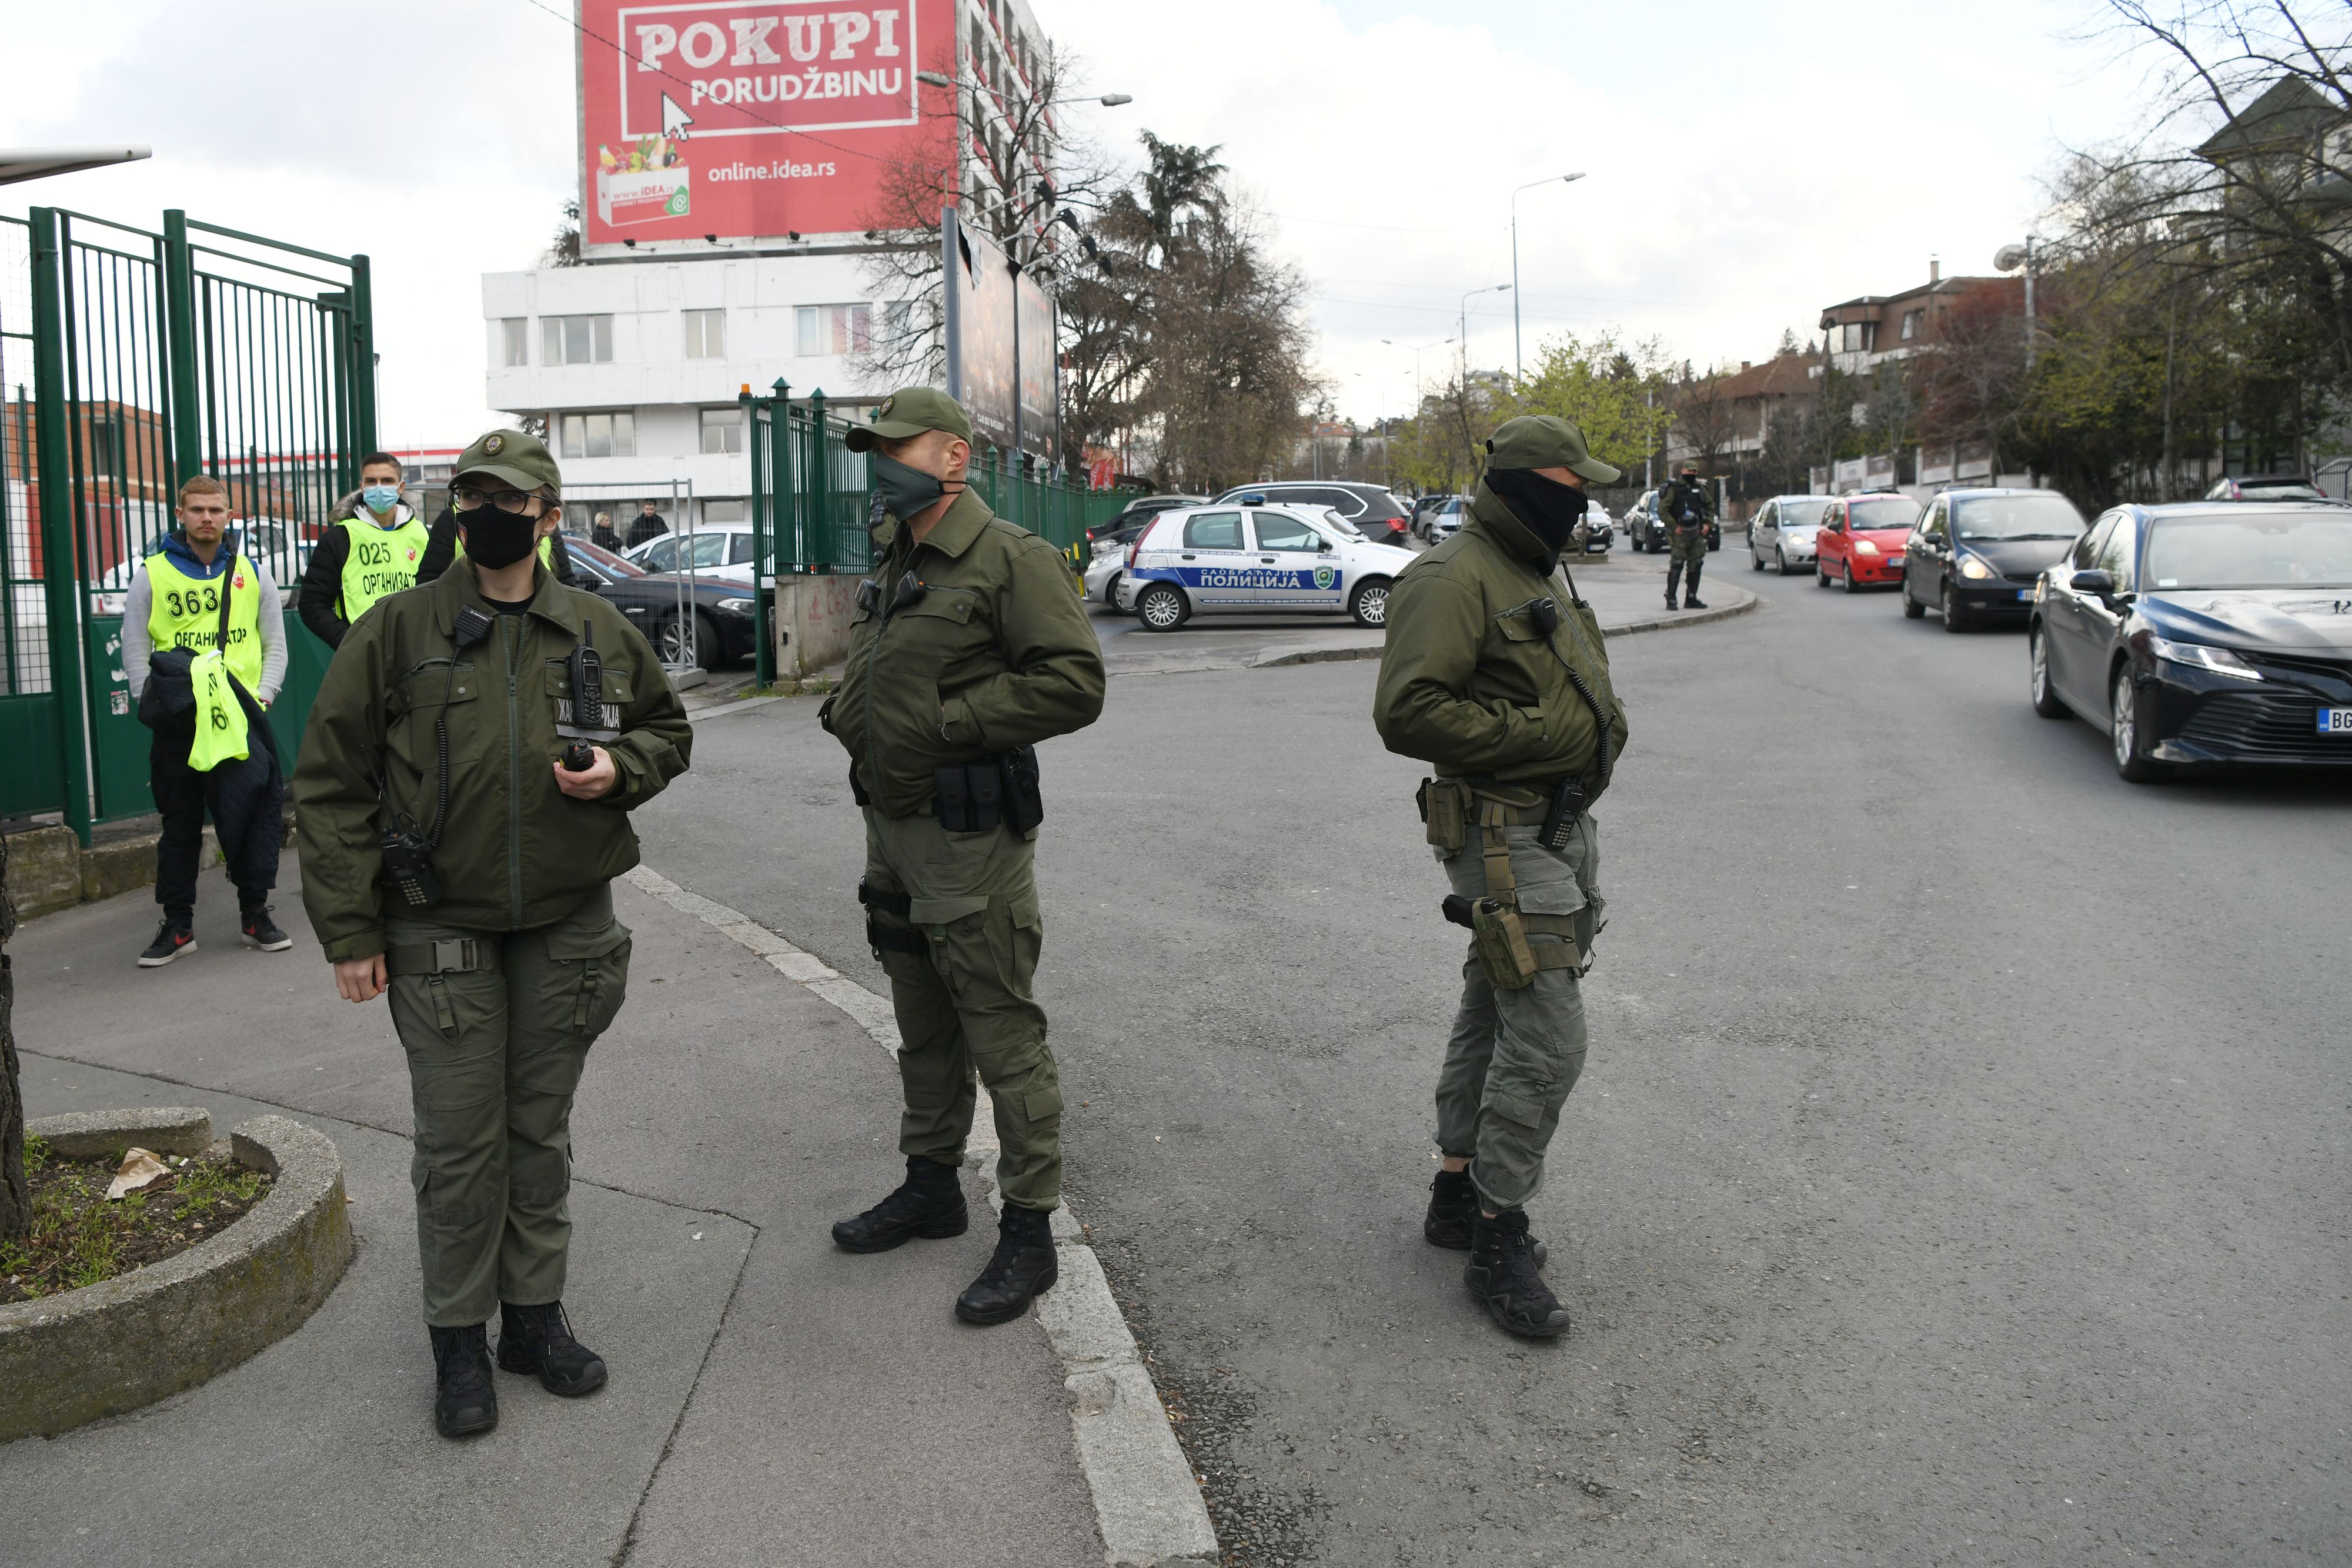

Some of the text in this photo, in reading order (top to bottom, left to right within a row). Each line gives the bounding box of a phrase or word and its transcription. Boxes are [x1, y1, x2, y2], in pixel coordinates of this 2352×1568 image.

[636, 9, 900, 72] POKUPI
[691, 66, 902, 106] PORUDŽBINU
[708, 159, 836, 182] online.idea.rs
[359, 542, 390, 566] 025
[363, 571, 416, 595] ОРГАНИЗАТО
[1201, 575, 1301, 588] ПОЛИЦИЈА
[166, 585, 220, 619] 363
[175, 628, 247, 647] ОРГАНИАТОР
[2333, 712, 2352, 728] BG
